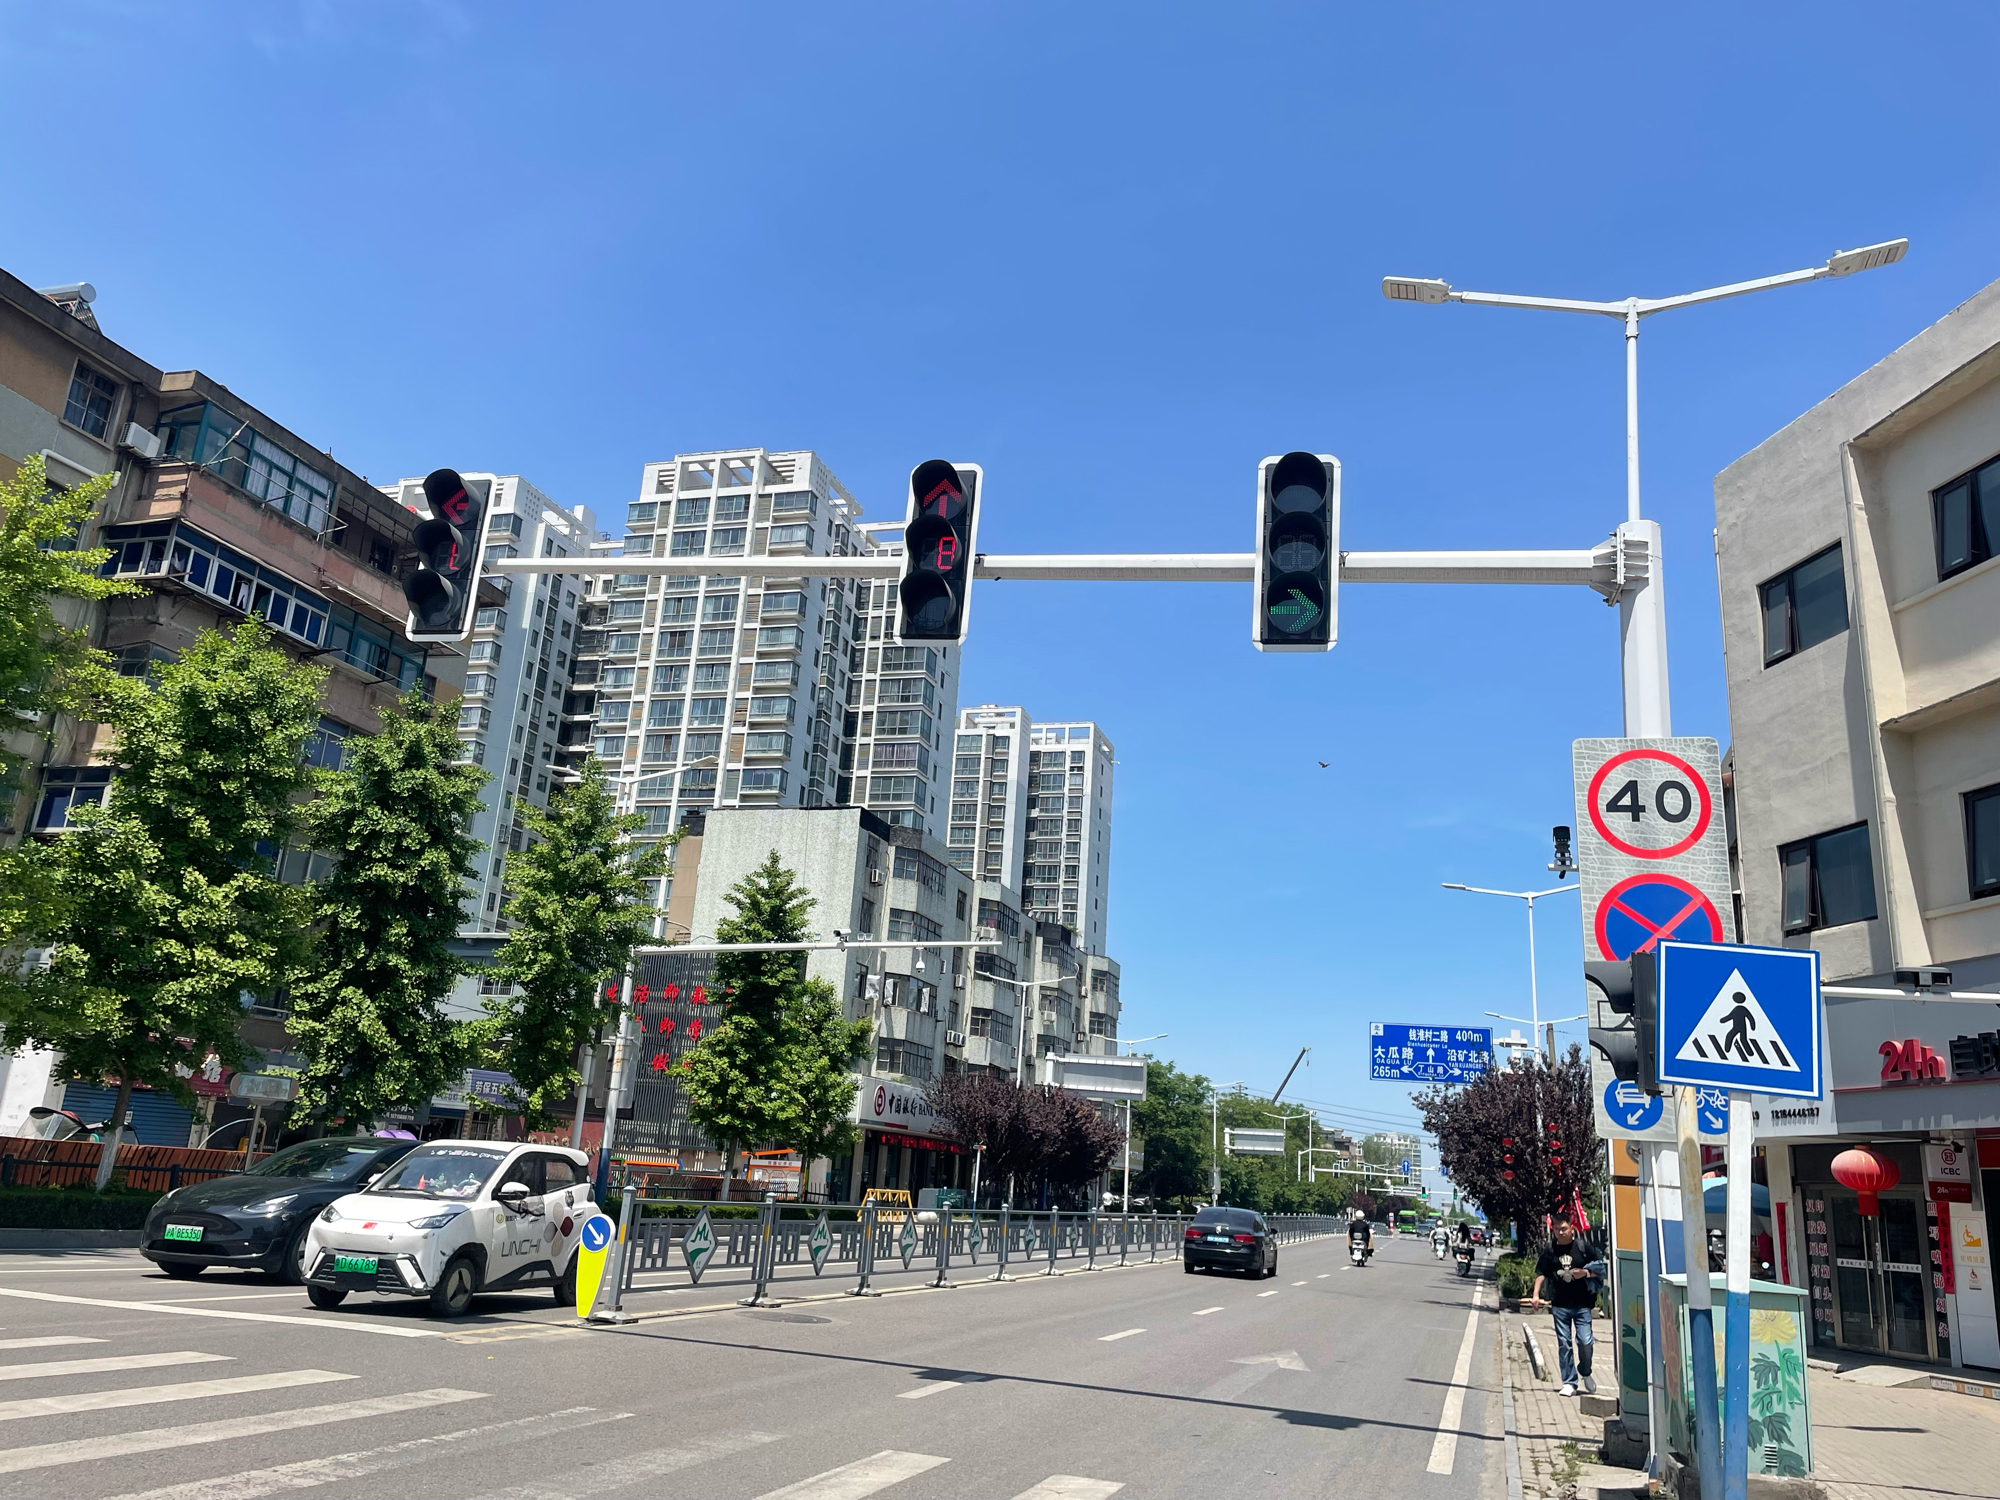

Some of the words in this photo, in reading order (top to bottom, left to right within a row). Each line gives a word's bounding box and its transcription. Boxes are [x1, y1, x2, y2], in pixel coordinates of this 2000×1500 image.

[1605, 779, 1692, 823] 40
[1456, 1030, 1483, 1042] 400m
[1374, 1046, 1414, 1060] 大瓜路
[1447, 1049, 1490, 1064] 沿矿北路
[1878, 1038, 1946, 1081] 24h
[1373, 1065, 1400, 1078] 265m
[1418, 1065, 1444, 1074] 丁山路
[889, 1092, 917, 1117] 中国银行
[1941, 1167, 1961, 1176] ICBC
[1937, 1186, 1949, 1194] 24h
